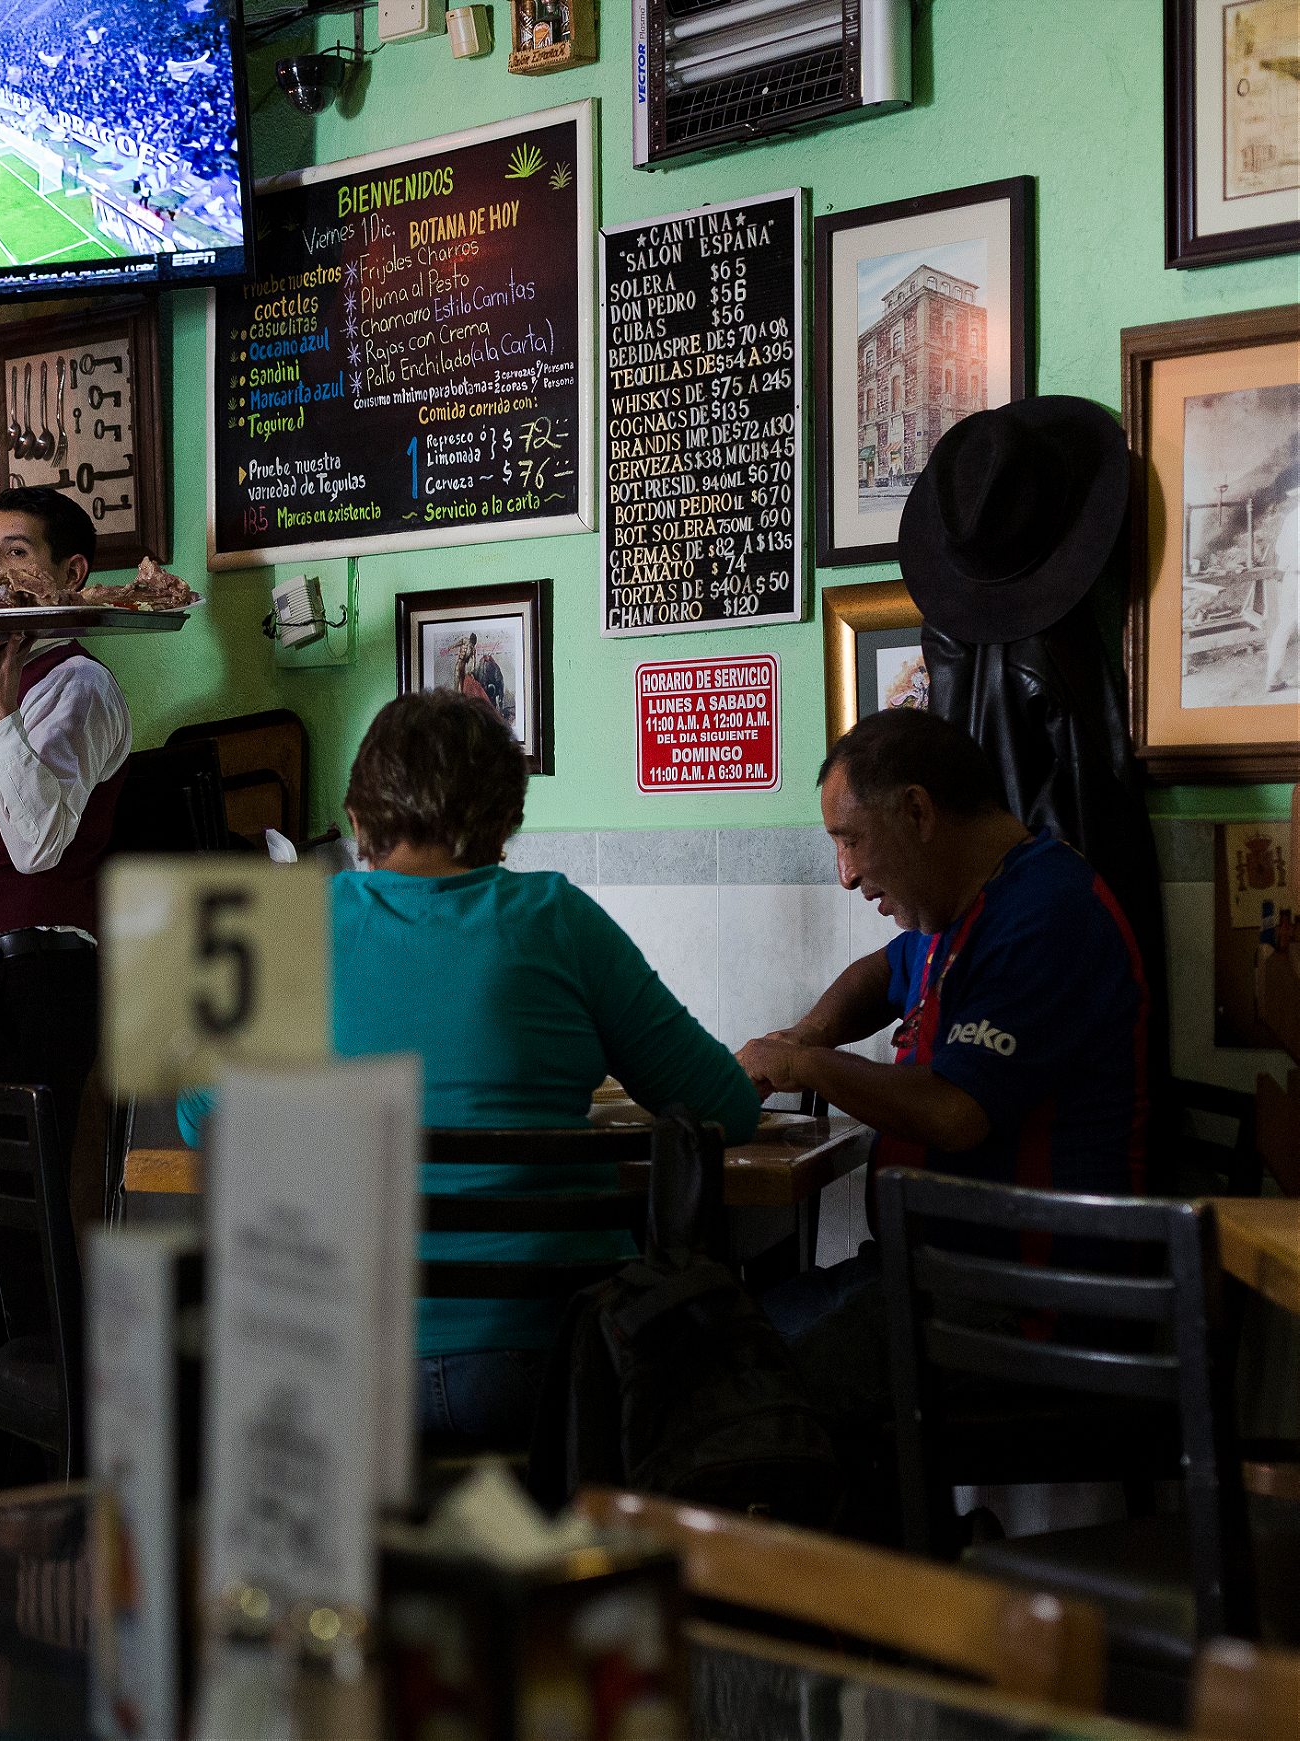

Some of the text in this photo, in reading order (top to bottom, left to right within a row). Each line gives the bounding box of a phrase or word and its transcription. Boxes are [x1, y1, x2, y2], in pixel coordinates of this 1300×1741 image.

[638, 43, 646, 103] VECTOR
[337, 167, 454, 218] BIENVENIDOS
[302, 225, 355, 255] Viernes
[409, 199, 521, 251] BOTANA DE HOY
[650, 211, 733, 247] CANTINA
[172, 251, 216, 267] ESPN
[359, 240, 479, 285] Frijoles Charros
[288, 263, 342, 290] nuestros
[361, 262, 470, 314] Pluma al Pesto
[609, 271, 677, 302] SOLERA
[254, 293, 319, 322] cocteles
[360, 307, 431, 338] Chamorro
[434, 294, 471, 322] Estilo
[610, 279, 747, 325] DON PEDRO $56
[250, 316, 318, 340] casuelitas
[612, 303, 746, 345] CUBAS $56
[707, 317, 789, 352] DE A 98
[250, 326, 330, 361] Oceano azul
[365, 321, 491, 366] Rajas con Crema
[249, 364, 300, 388] Sandini
[366, 367, 396, 392] Pollo
[400, 350, 471, 381] Enchilado
[610, 340, 794, 391] TEQUILAS DE $54 A 395
[250, 370, 346, 410] Margarita azul
[354, 396, 391, 410] consumo
[429, 385, 449, 403] para
[611, 368, 792, 416] WHISKYS $75 A 245
[419, 400, 465, 425] Comida
[469, 393, 512, 418] corrida
[609, 398, 750, 439] COGNACS DE $135
[426, 430, 475, 451] Refresco
[611, 432, 682, 460] BRANDIS
[711, 424, 732, 447] DE
[732, 420, 761, 442] $72
[726, 436, 795, 466] MICH $45
[249, 452, 342, 481] Pruebe nuestra
[406, 436, 418, 500] 1
[427, 446, 481, 468] Limonada
[248, 476, 297, 501] variedad
[300, 475, 316, 497] de
[425, 475, 474, 494] Cerveza
[702, 470, 745, 491] 940ML
[748, 461, 792, 484] $670
[277, 505, 312, 530] Marcas
[313, 509, 328, 525] en
[328, 501, 382, 522] existencia
[424, 491, 540, 522] Servicio a la carta
[648, 499, 676, 521] DON
[679, 493, 732, 517] PEDRO
[751, 484, 792, 506] $670
[615, 507, 792, 547] BOT. SOLERA 750ML 690
[609, 542, 682, 569] CREMAS
[685, 539, 705, 562] DE
[743, 534, 753, 556] A
[756, 530, 794, 552] $135
[611, 560, 694, 586] CLAMATO
[611, 583, 678, 608] TORTAS
[682, 580, 704, 600] DE
[710, 574, 741, 600] $40
[741, 574, 753, 595] A
[723, 595, 760, 616] $120
[642, 665, 770, 693] HORARIO DE SERVICIO
[648, 692, 767, 715] LUNES A SABADO
[646, 711, 770, 732] 11:00 A.M. A 12:00 A.M.
[656, 729, 759, 744] DEL DIA SIGUIENTE
[671, 746, 743, 763] DOMINGO
[649, 763, 768, 782] 11:00 A.M. A 6:30 P.M.
[193, 886, 260, 1041] 5
